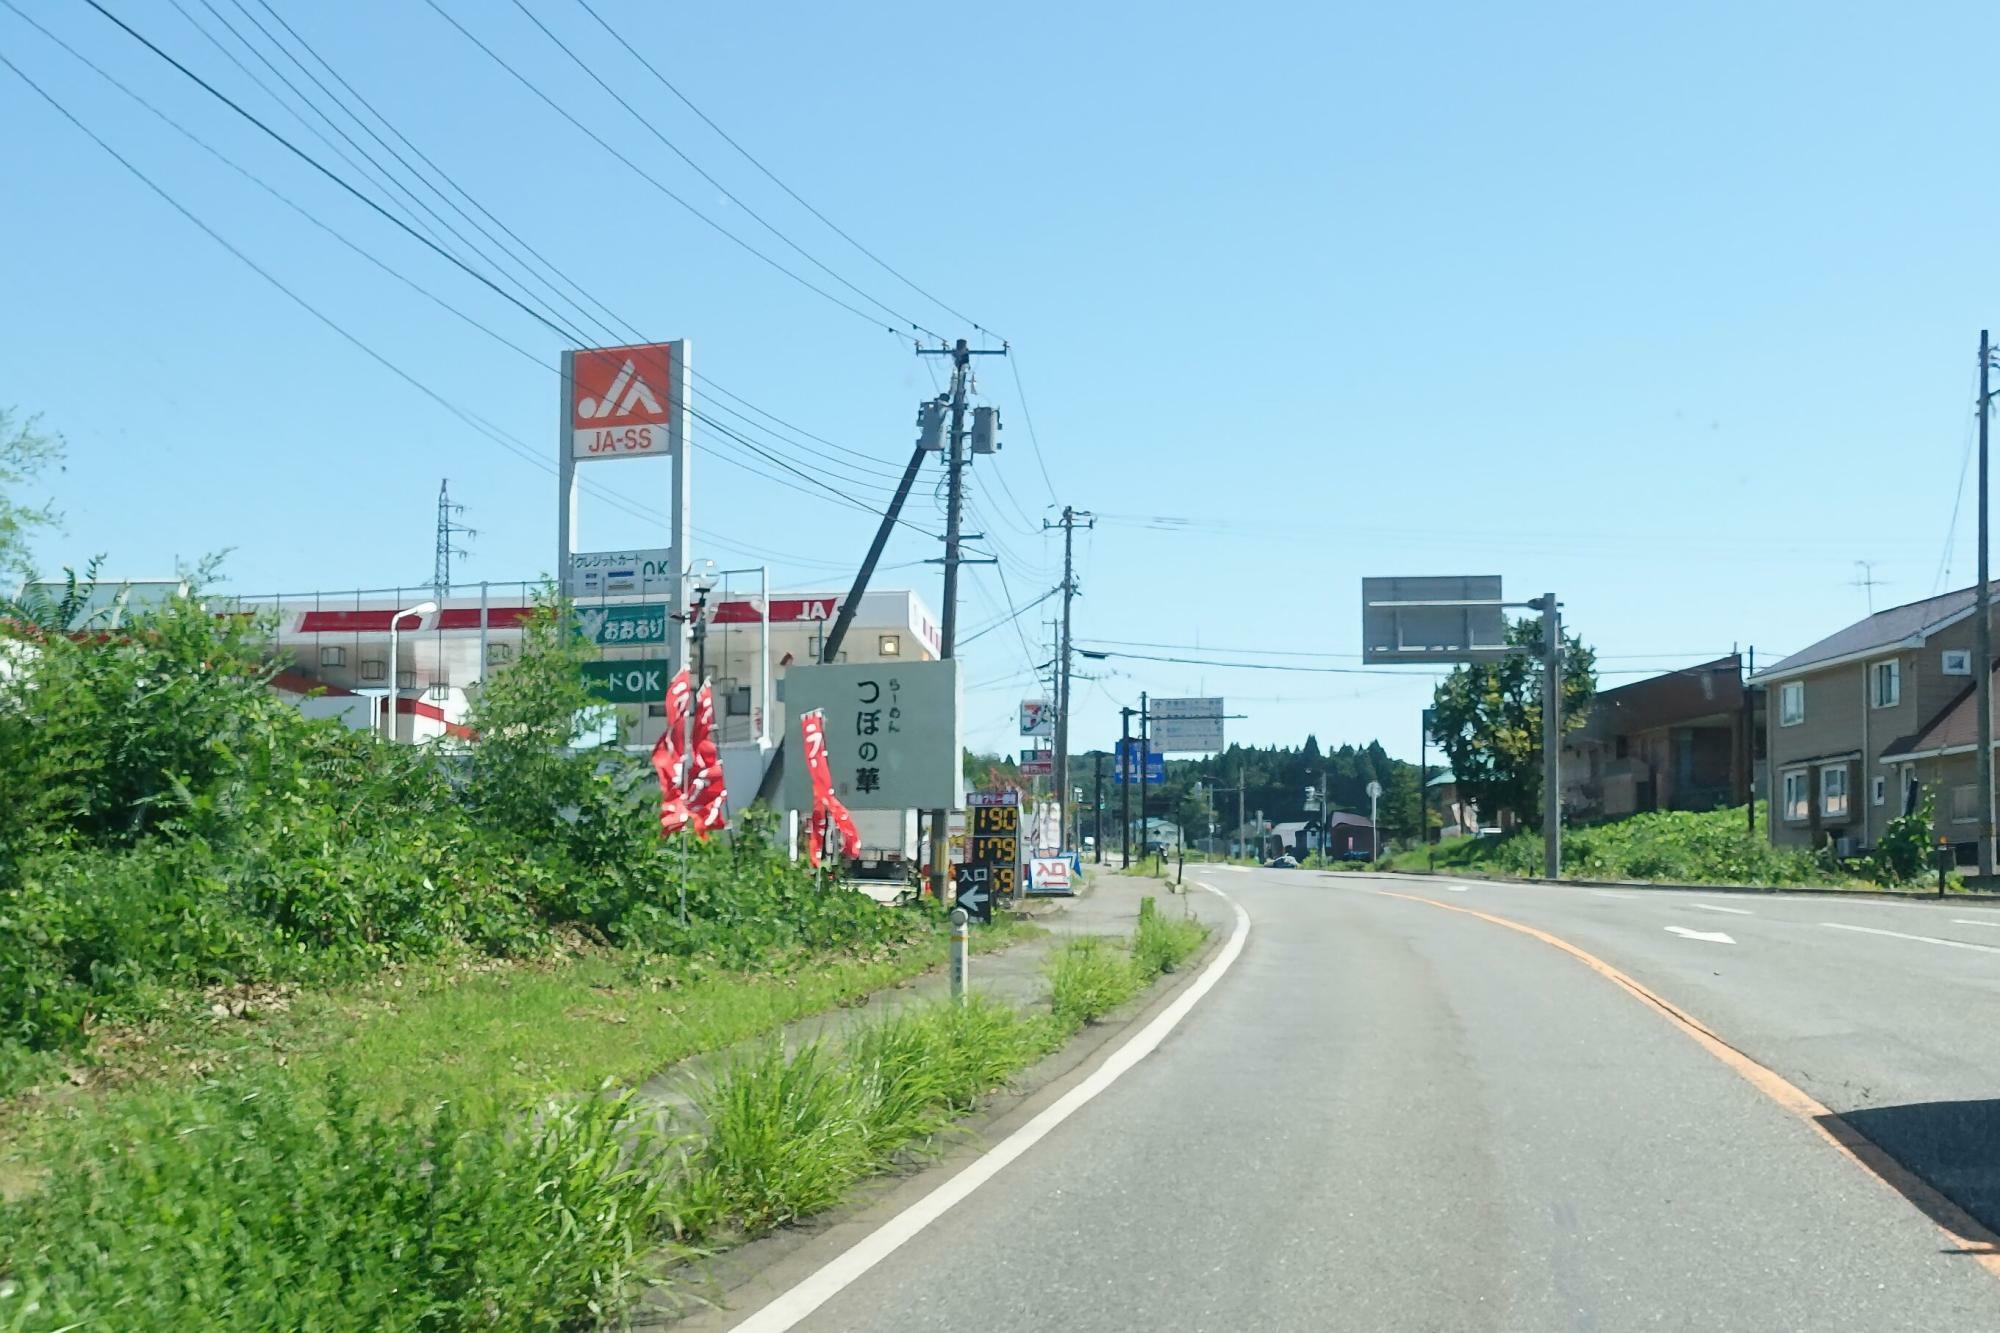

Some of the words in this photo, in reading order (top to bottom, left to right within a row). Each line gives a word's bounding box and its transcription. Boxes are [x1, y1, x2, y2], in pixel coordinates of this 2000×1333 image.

[588, 428, 652, 453] JA-SS
[795, 601, 828, 620] JA
[856, 680, 881, 794] つぼの華
[980, 807, 1017, 831] 190
[979, 838, 1016, 861] 179
[959, 868, 988, 882] 入口
[1037, 862, 1067, 877] 入口
